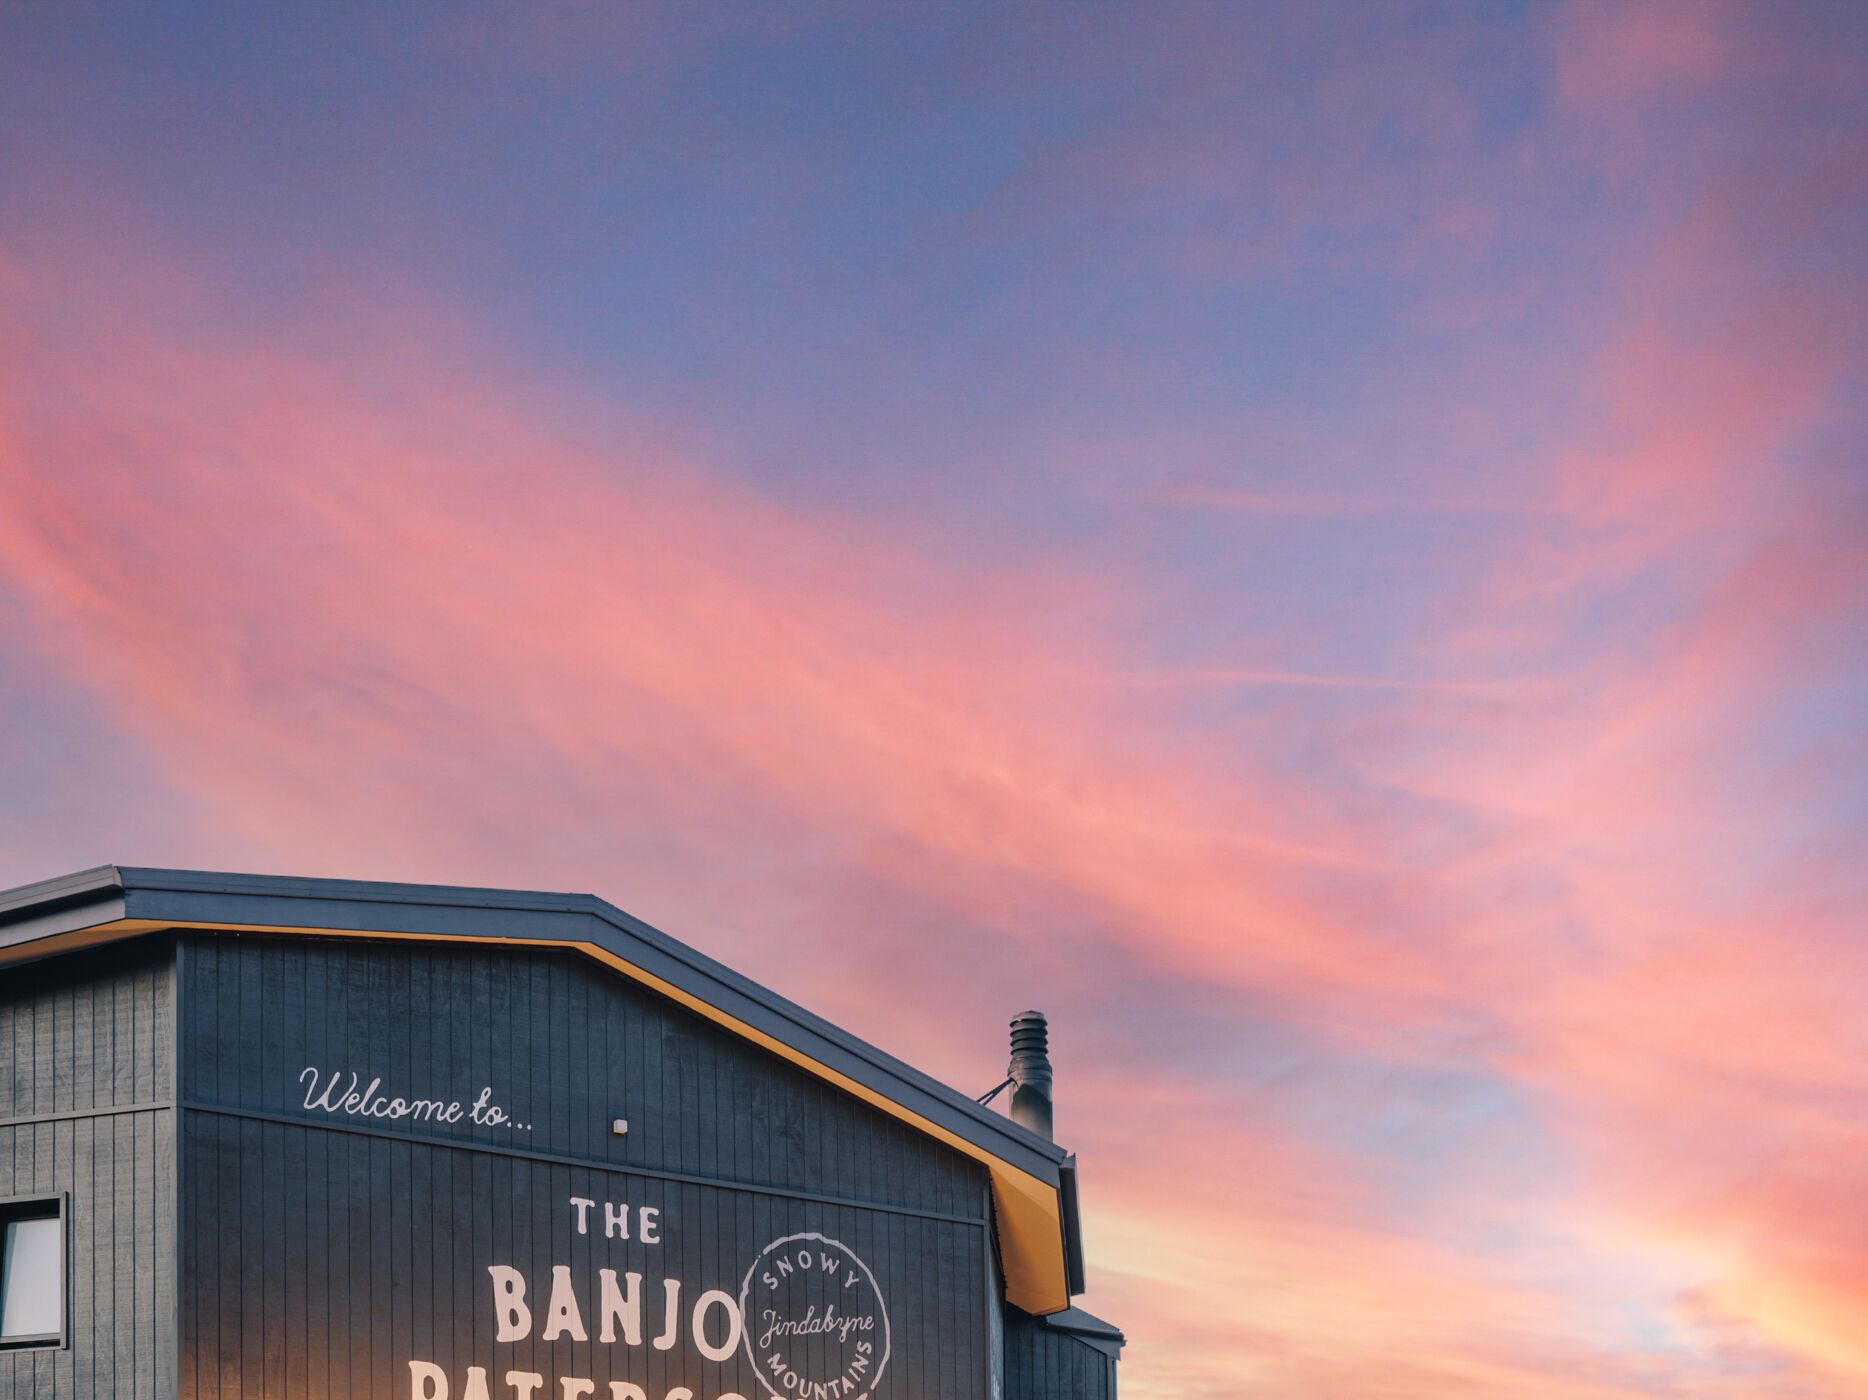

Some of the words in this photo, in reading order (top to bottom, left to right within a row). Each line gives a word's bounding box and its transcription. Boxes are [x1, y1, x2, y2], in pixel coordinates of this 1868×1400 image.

[299, 1066, 464, 1124] Welcome
[468, 1086, 533, 1132] to...
[569, 1196, 661, 1244] THE
[762, 1250, 860, 1290] SNOWY
[487, 1264, 742, 1361] BANJO
[759, 1304, 875, 1349] Jindabyne
[767, 1340, 872, 1400] MOUNTAINS
